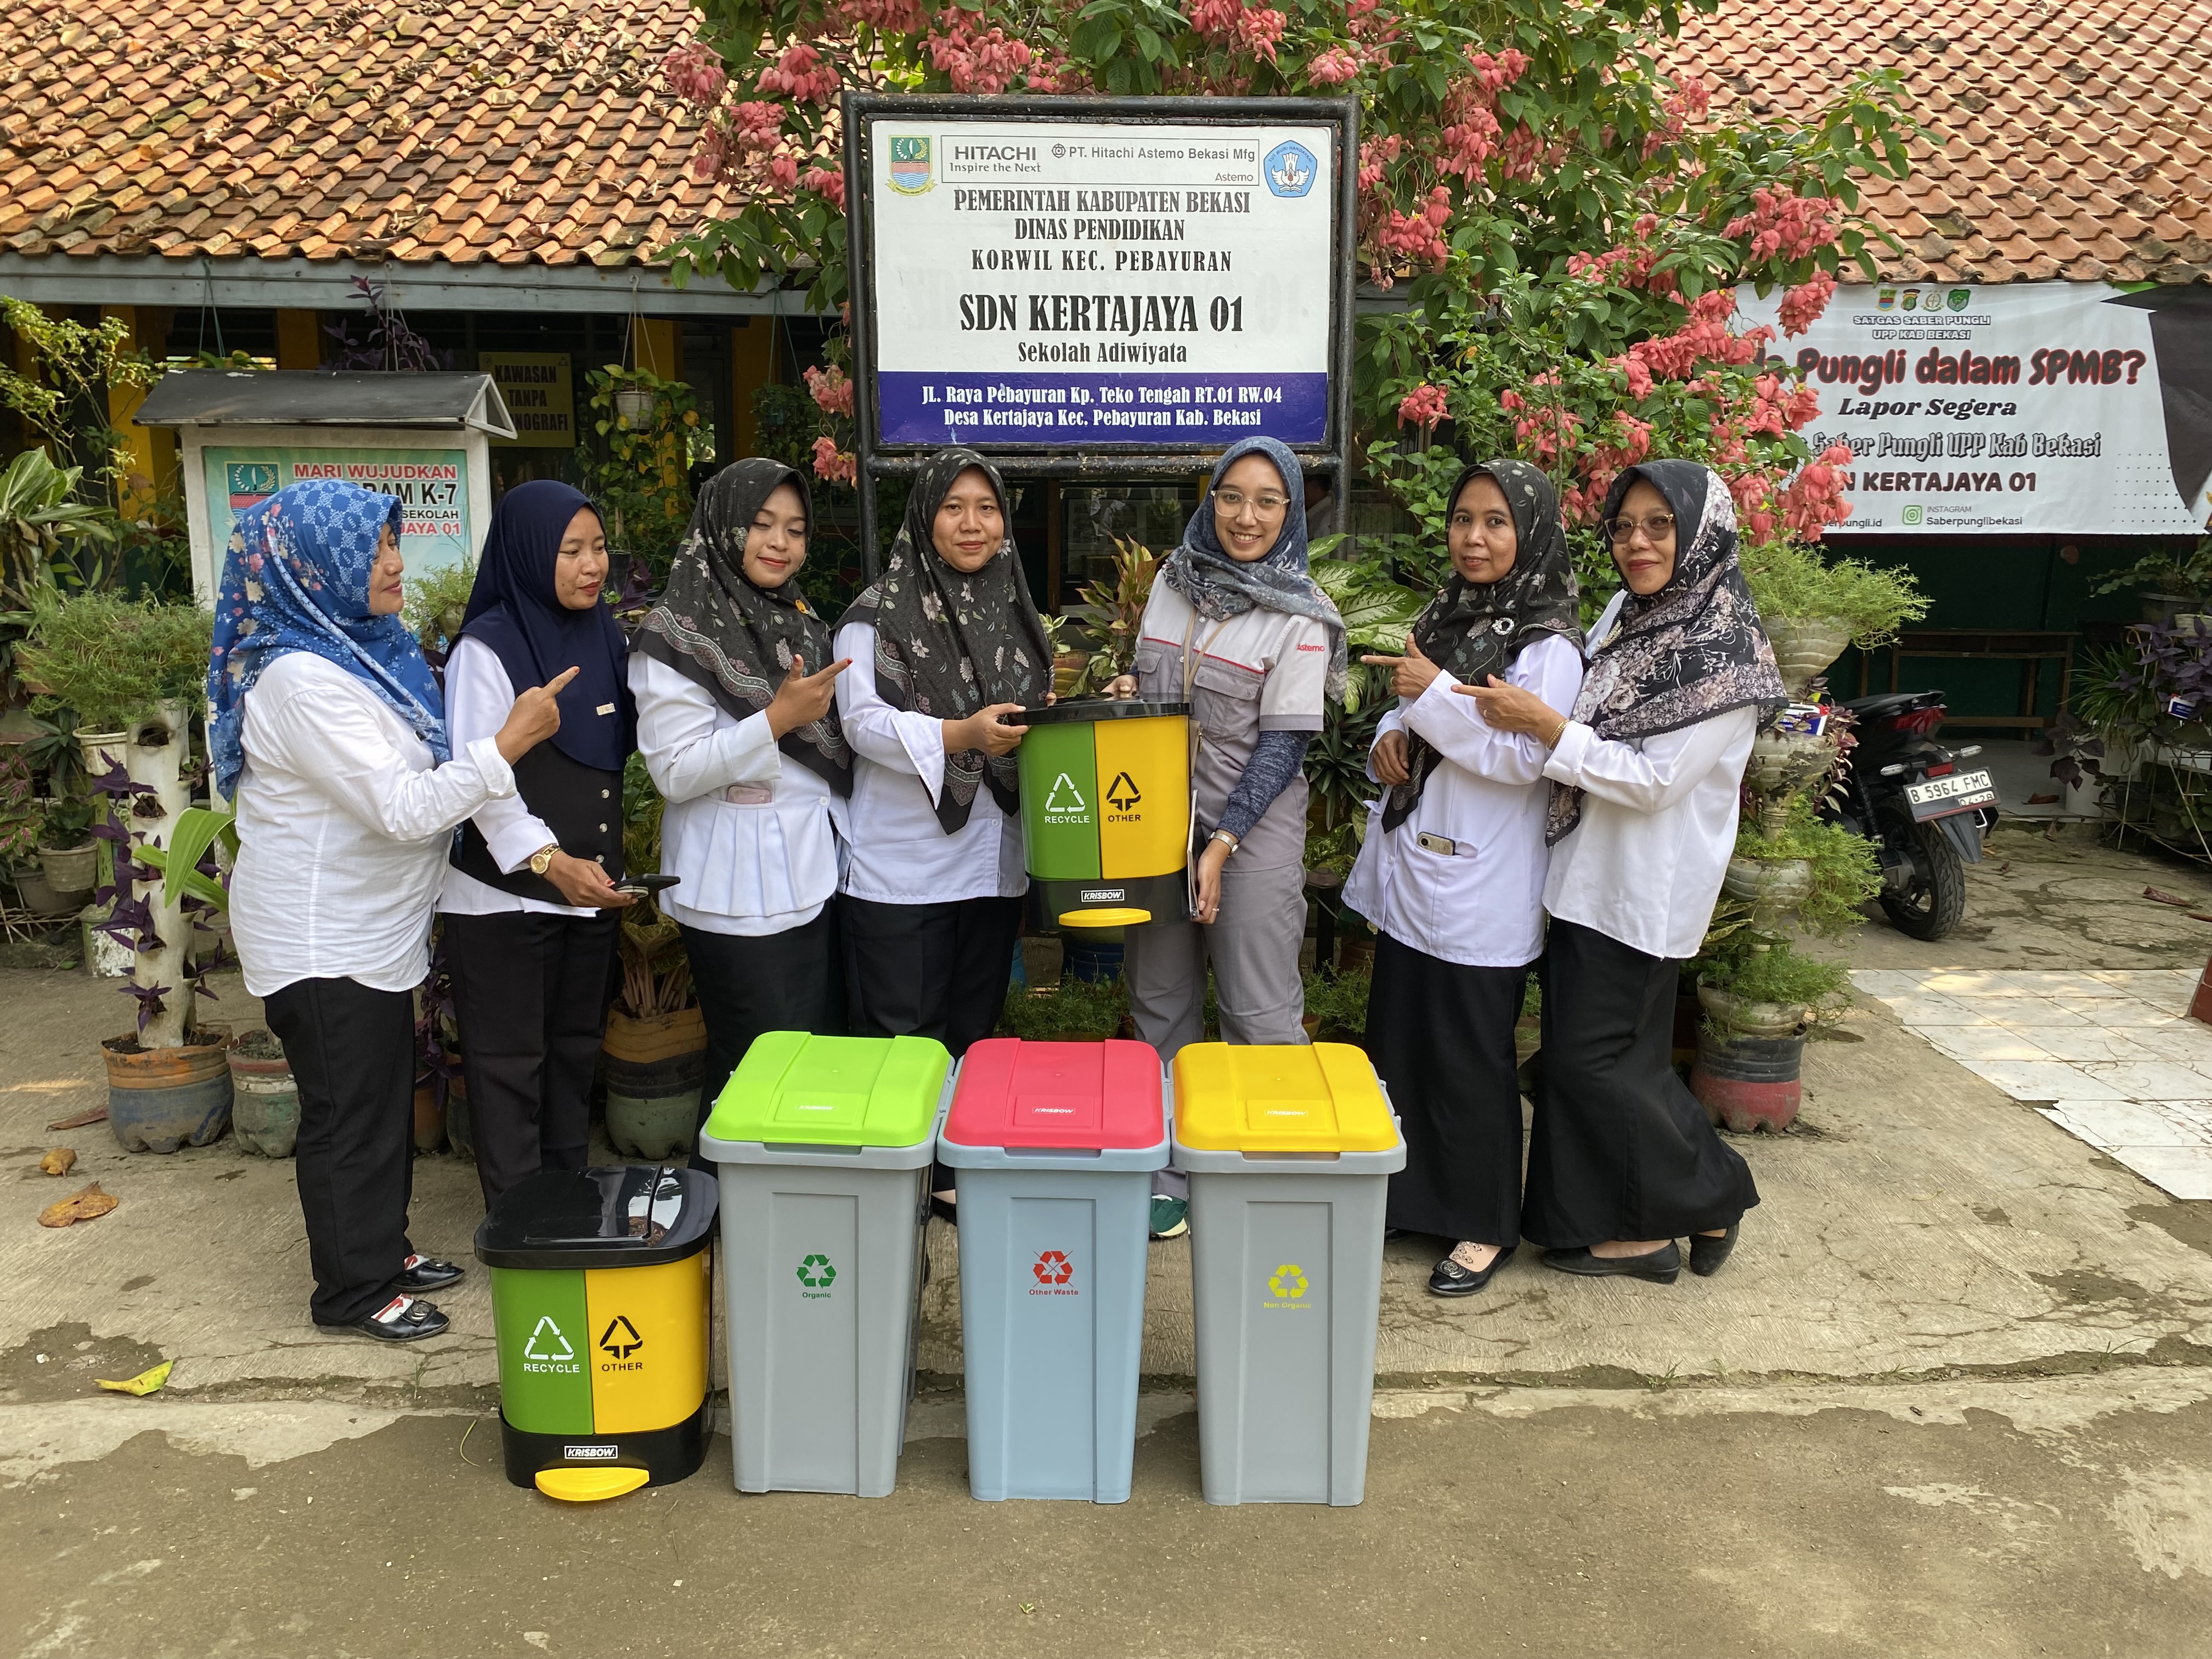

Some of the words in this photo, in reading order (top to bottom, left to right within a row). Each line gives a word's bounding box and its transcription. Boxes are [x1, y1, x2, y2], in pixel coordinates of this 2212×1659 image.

[955, 146, 1036, 161] HITACHI
[1069, 147, 1087, 158] PT.
[1091, 146, 1134, 159] Hitachi
[1138, 147, 1184, 159] Astemo
[1188, 148, 1229, 160] Bekasi
[1233, 149, 1255, 162] Mfg
[950, 162, 990, 173] Inspire
[994, 163, 1011, 172] the
[1015, 163, 1041, 172] Next
[1215, 172, 1254, 182] Astemo
[953, 189, 1070, 211] PEMERINTAH
[1076, 190, 1180, 212] KABUPATEN
[1186, 191, 1250, 213] BEKASI
[1014, 218, 1067, 240] DINAS
[1074, 218, 1185, 240] PENDIDIKAN
[972, 249, 1052, 270] KORWIL
[1062, 250, 1104, 270] KEC.
[1115, 250, 1231, 272] PEBAYURAN
[960, 293, 1018, 331] SDN
[1028, 295, 1198, 337] KERTAJAYA
[1210, 295, 1243, 332] 01
[1853, 315, 1901, 325] SATGAS
[1903, 315, 1944, 325] SABER
[1945, 315, 1991, 325] PUNGLI
[1872, 330, 1897, 340] UPP
[1899, 330, 1925, 340] KAB
[1927, 330, 1971, 340] BEKASI
[1018, 342, 1090, 363] Sekolah
[1097, 342, 1187, 365] Adiwiyata
[495, 365, 557, 383] KAWASAN
[1797, 347, 1907, 396] Pungli
[1915, 346, 2021, 385] dalam
[2028, 348, 2147, 386] SPMB?
[507, 389, 548, 407] TANPA
[922, 386, 941, 405] JL.
[945, 386, 983, 405] Raya
[987, 386, 1066, 405] Pebayuran
[1070, 386, 1094, 405] Kp.
[1099, 386, 1134, 403] Teko
[1138, 386, 1190, 405] Tengah
[1194, 386, 1233, 403] RT.01
[1238, 386, 1282, 403] RW.04
[1837, 398, 1922, 420] Lapor
[1925, 398, 2017, 421] Segera
[510, 413, 568, 431] NOGRAFI
[944, 409, 979, 426] Desa
[983, 409, 1053, 427] Kertajaya
[1058, 409, 1088, 426] Kec.
[1093, 409, 1171, 428] Pebayuran
[1176, 409, 1208, 426] Kab.
[1212, 409, 1261, 426] Bekasi
[1877, 431, 1944, 462] Pungli
[1947, 432, 1986, 458] UPP
[1988, 432, 2028, 458] Kab
[2032, 432, 2102, 458] Bekasi
[294, 464, 342, 477] MARI
[347, 465, 456, 479] WUJUDKAN
[1863, 471, 2003, 492] KERTAJAYA
[2008, 472, 2036, 492] 01
[421, 483, 456, 505] K-7
[402, 510, 459, 519] SEKOLAH
[1926, 516, 2023, 527] Saberpunglibekasi
[400, 522, 438, 534] JAYA
[443, 522, 460, 534] 01
[1296, 643, 1325, 652] Astemo
[1910, 789, 1920, 803] B
[1925, 780, 1958, 799] 5964
[1962, 774, 1989, 791] FMC
[1045, 815, 1090, 824] RECYCLE
[1108, 814, 1141, 822] OTHER
[802, 1291, 831, 1300] Organic
[1281, 1302, 1312, 1310] Organic
[523, 1363, 580, 1373] RECYCLE
[601, 1362, 643, 1372] OTHER
